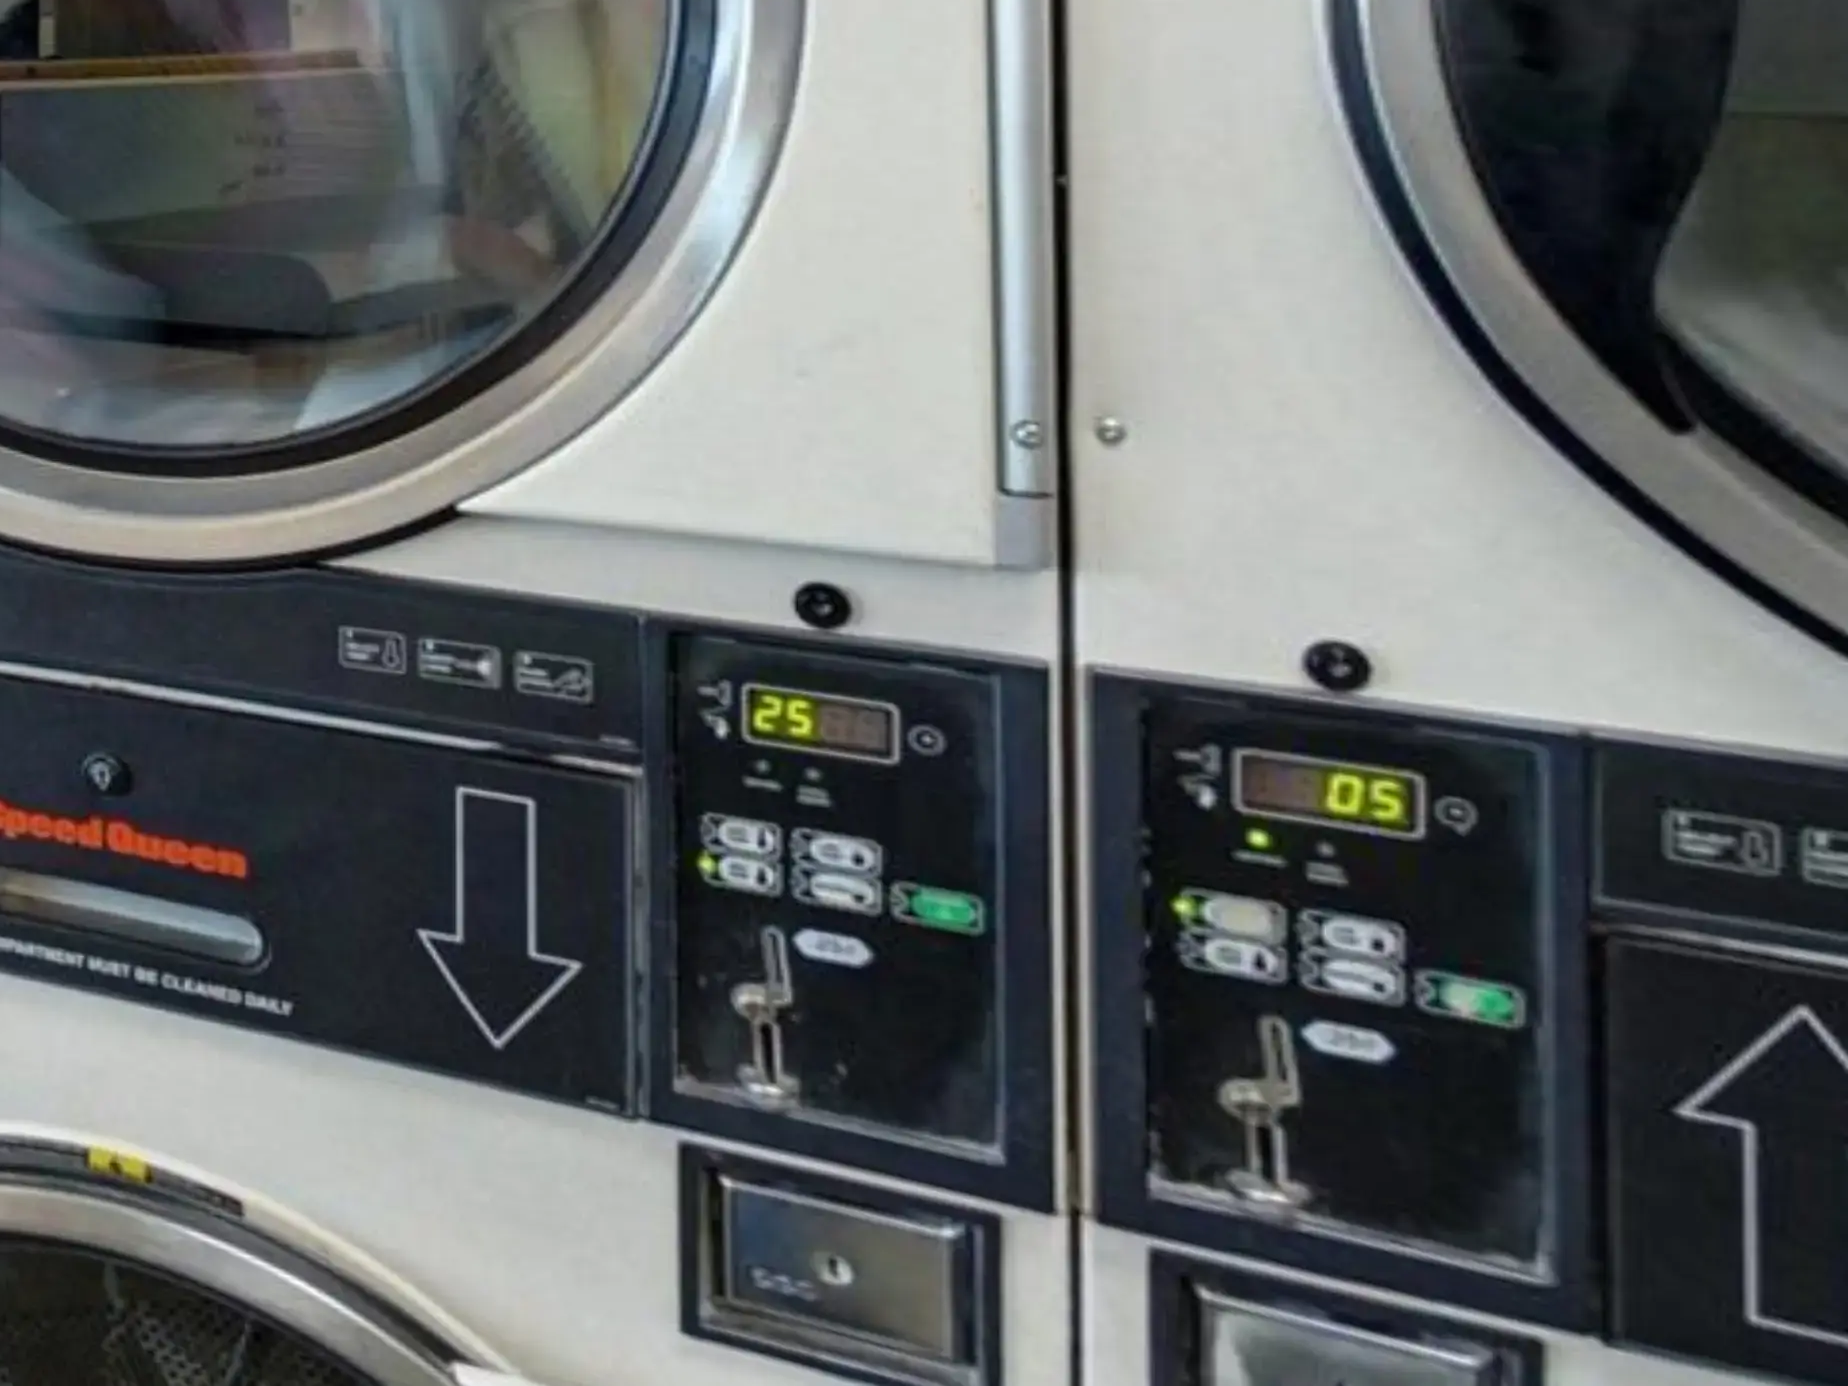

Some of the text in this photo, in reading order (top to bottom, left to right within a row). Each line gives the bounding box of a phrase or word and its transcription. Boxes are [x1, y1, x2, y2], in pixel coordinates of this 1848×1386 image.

[754, 695, 812, 737] 25
[1327, 774, 1403, 821] 05
[108, 821, 247, 878] Queen
